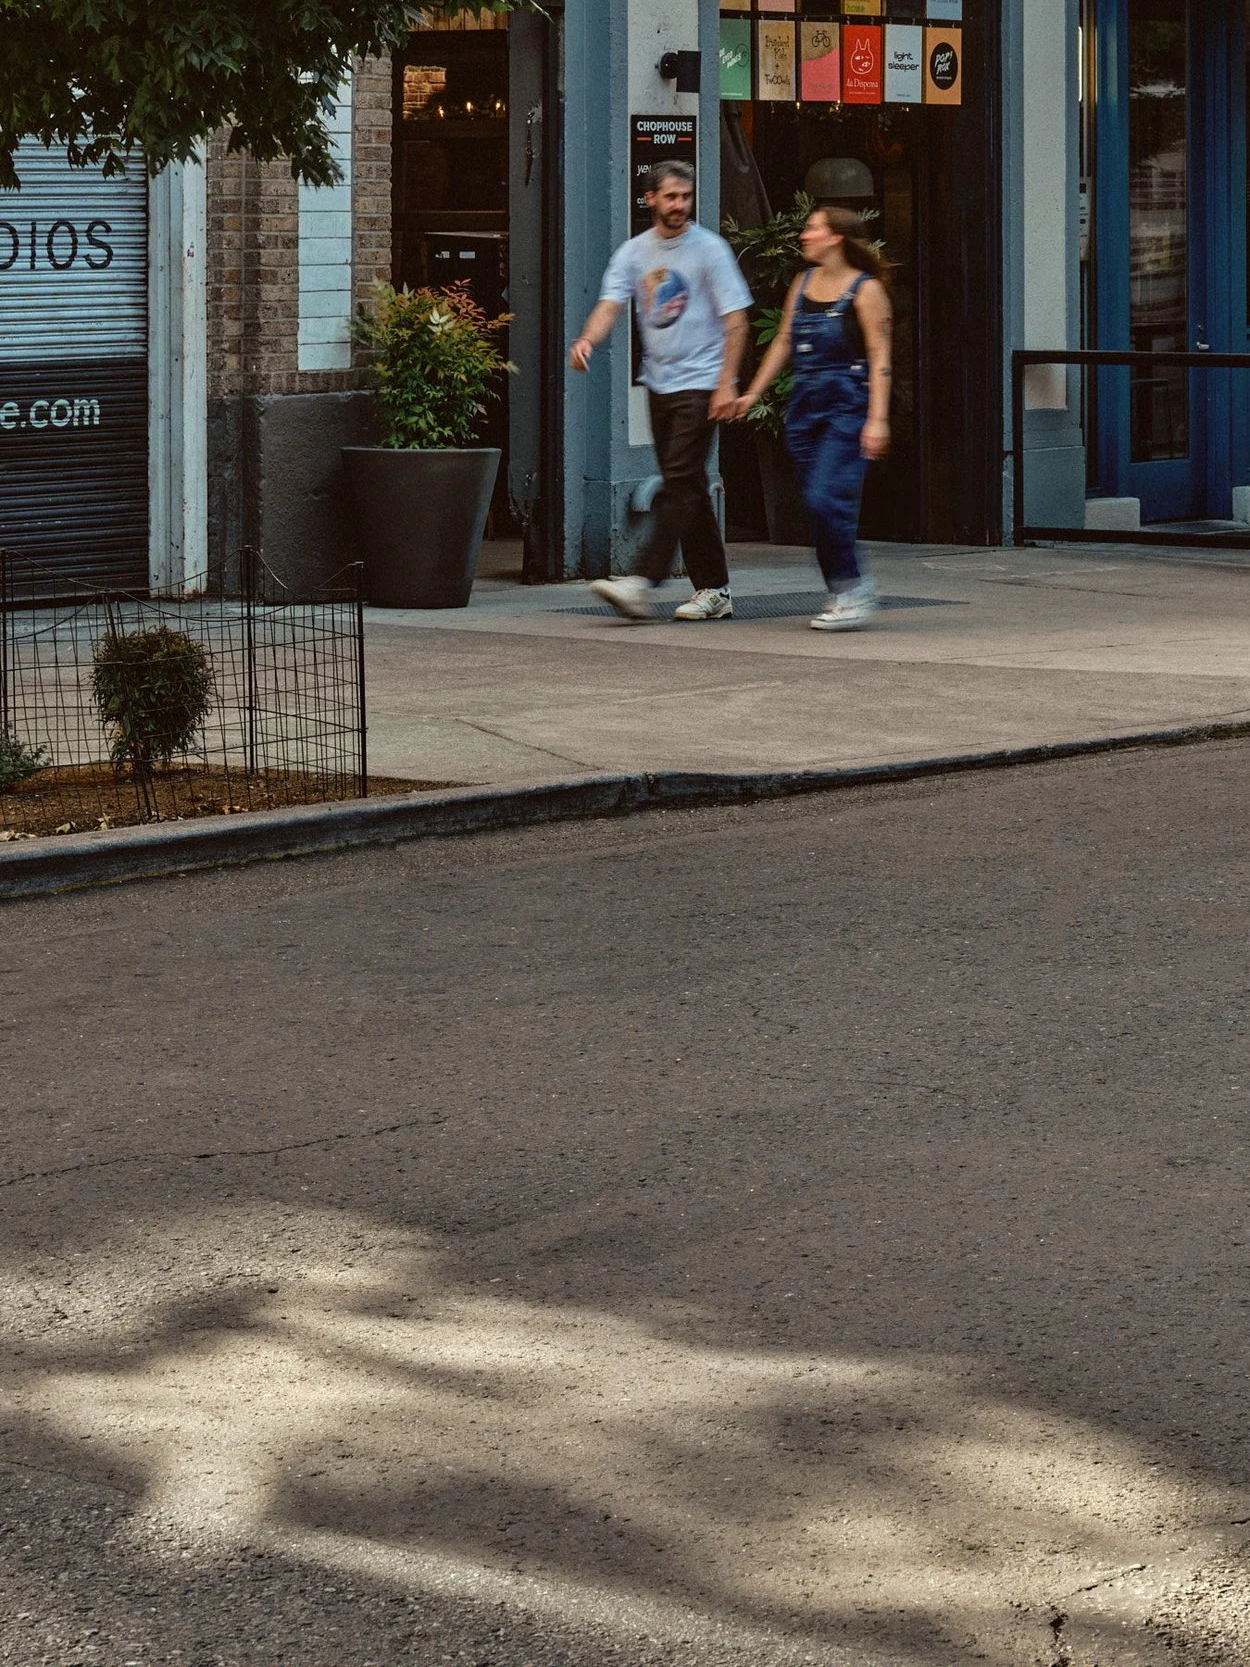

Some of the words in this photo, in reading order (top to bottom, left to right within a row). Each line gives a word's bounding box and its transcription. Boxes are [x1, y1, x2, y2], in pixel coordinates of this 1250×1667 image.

[893, 51, 913, 63] light
[888, 61, 920, 72] sleeper
[853, 78, 878, 91] Dispensa
[637, 121, 693, 132] CHOPHOUSE
[653, 134, 676, 144] ROW
